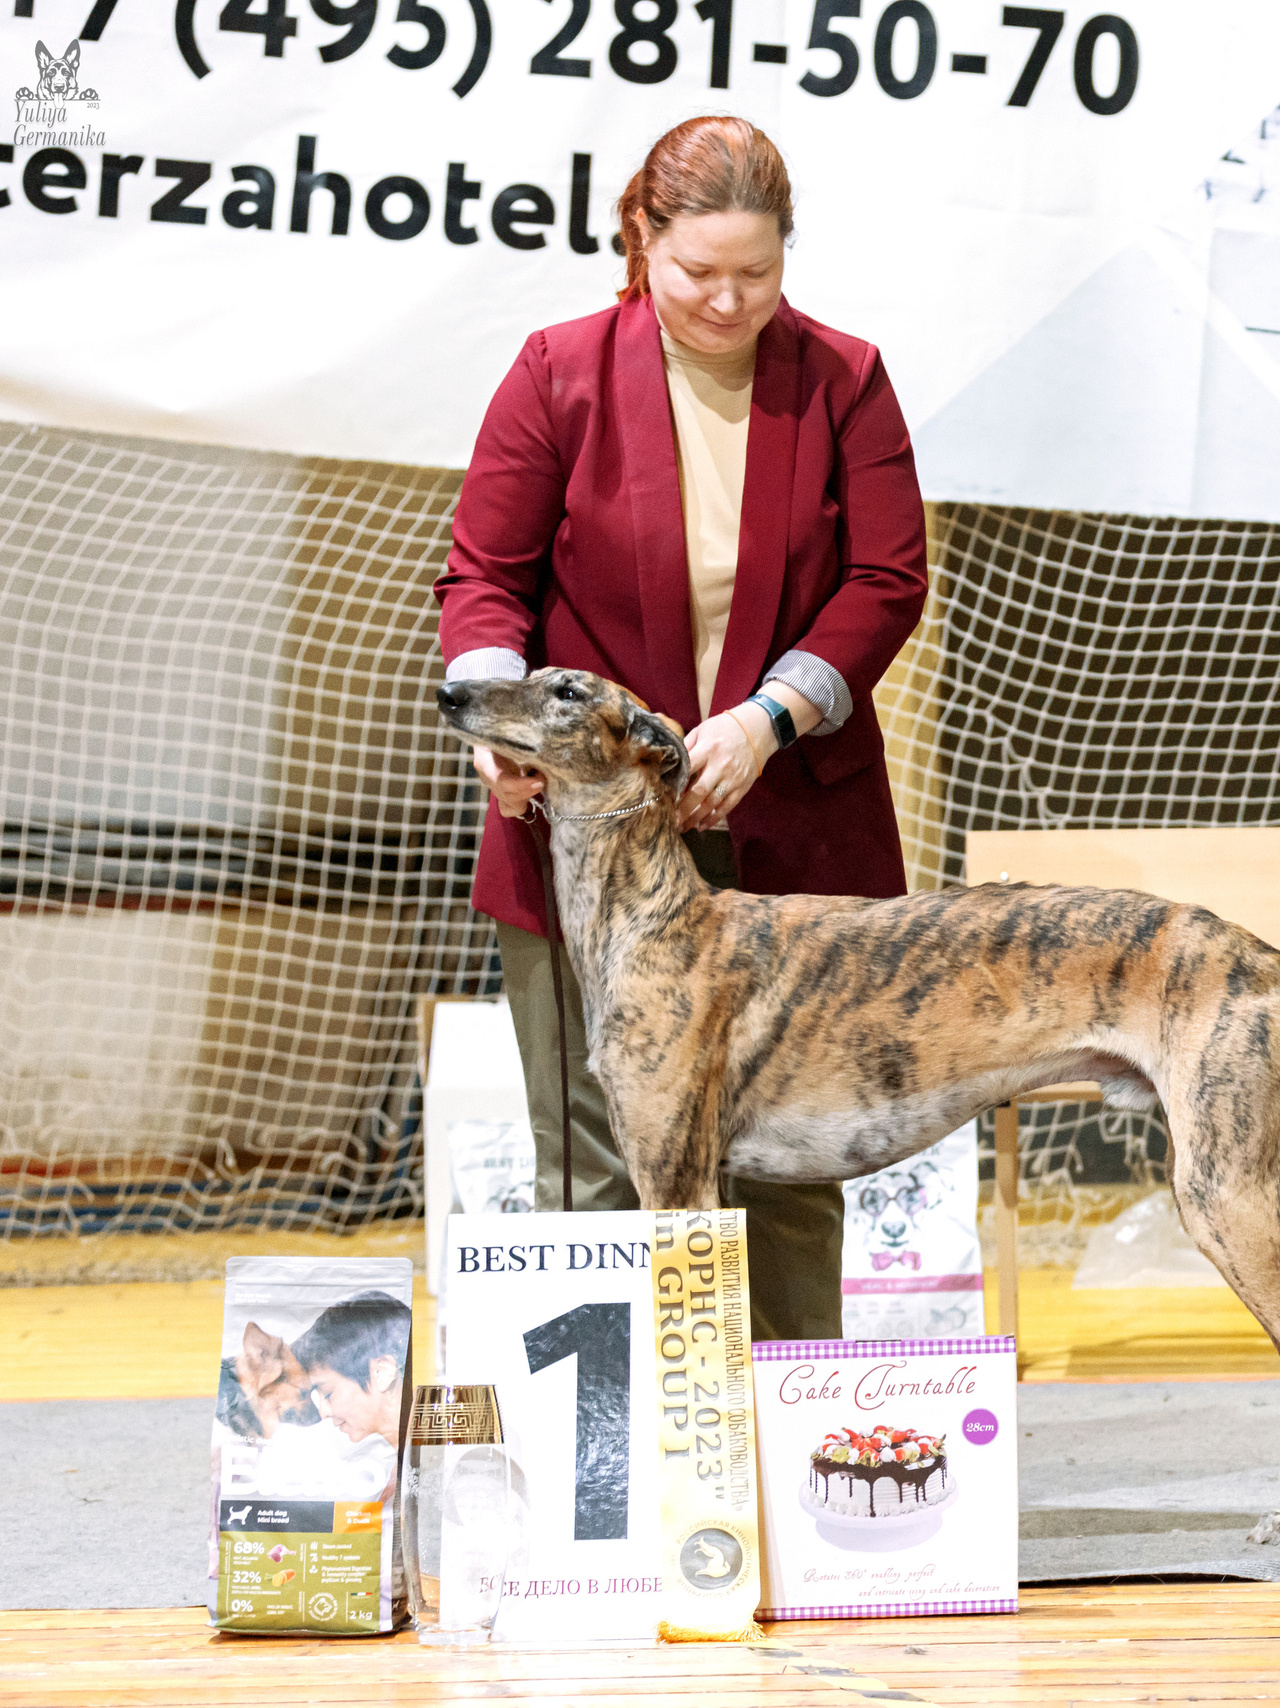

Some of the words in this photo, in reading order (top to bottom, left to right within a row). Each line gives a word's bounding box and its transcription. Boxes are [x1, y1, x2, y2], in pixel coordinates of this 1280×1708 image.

[529, 0, 1140, 116] 281-50-70
[457, 1244, 554, 1273] BEST
[720, 1240, 741, 1300] РАЗВИТИЯ
[657, 1266, 689, 1431] GROUP
[720, 1302, 746, 1405] НАЦИОНАЛЬНОГО
[779, 1364, 842, 1405] Cake
[854, 1360, 977, 1411] Turntable
[522, 1301, 631, 1541] 1
[966, 1422, 995, 1432] 28cm
[233, 1541, 265, 1555] 68%
[232, 1570, 262, 1584] 32%
[524, 1579, 580, 1599] ДЕЛО
[587, 1578, 599, 1594] В
[231, 1599, 253, 1612] 0%
[349, 1610, 357, 1620] 2
[358, 1610, 373, 1621] kg
